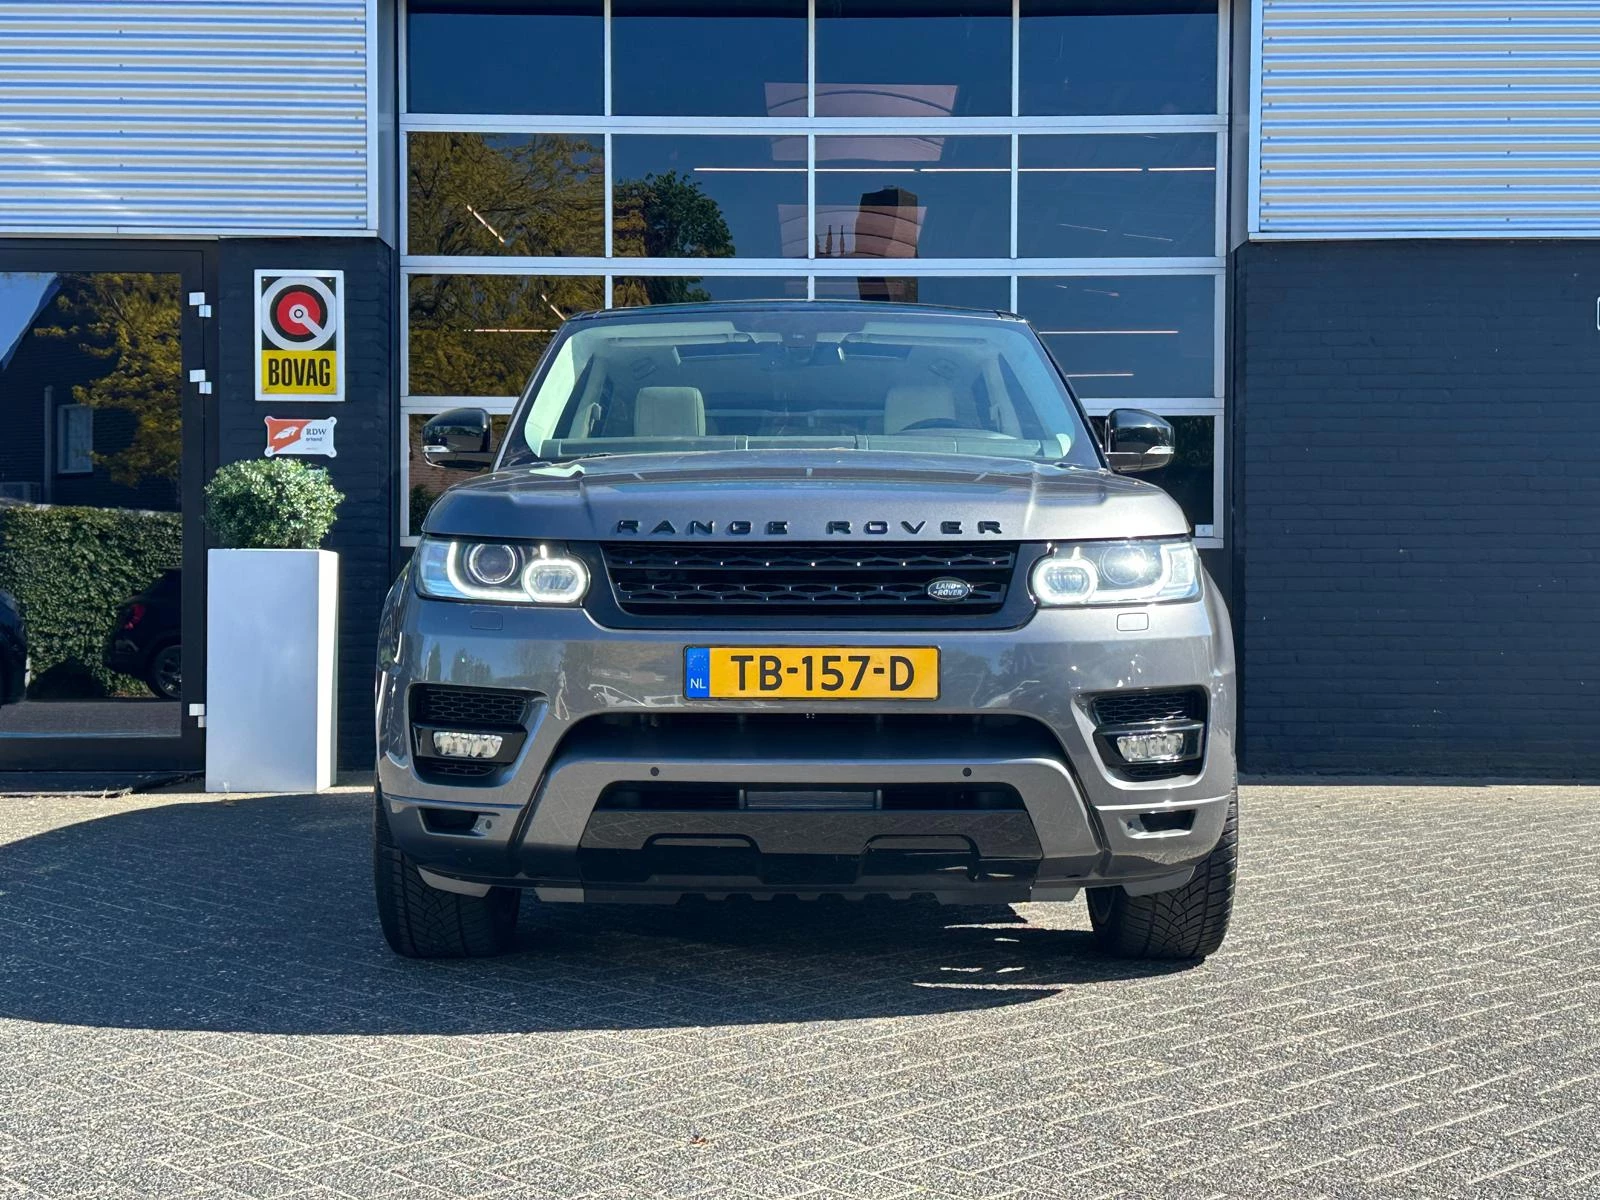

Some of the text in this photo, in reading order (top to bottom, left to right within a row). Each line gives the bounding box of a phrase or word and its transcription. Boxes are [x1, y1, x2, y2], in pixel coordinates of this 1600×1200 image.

[268, 358, 330, 386] BOVAG
[615, 520, 1002, 535] RANGE ROVER
[690, 678, 707, 689] NL
[730, 655, 915, 691] TB-157-D
